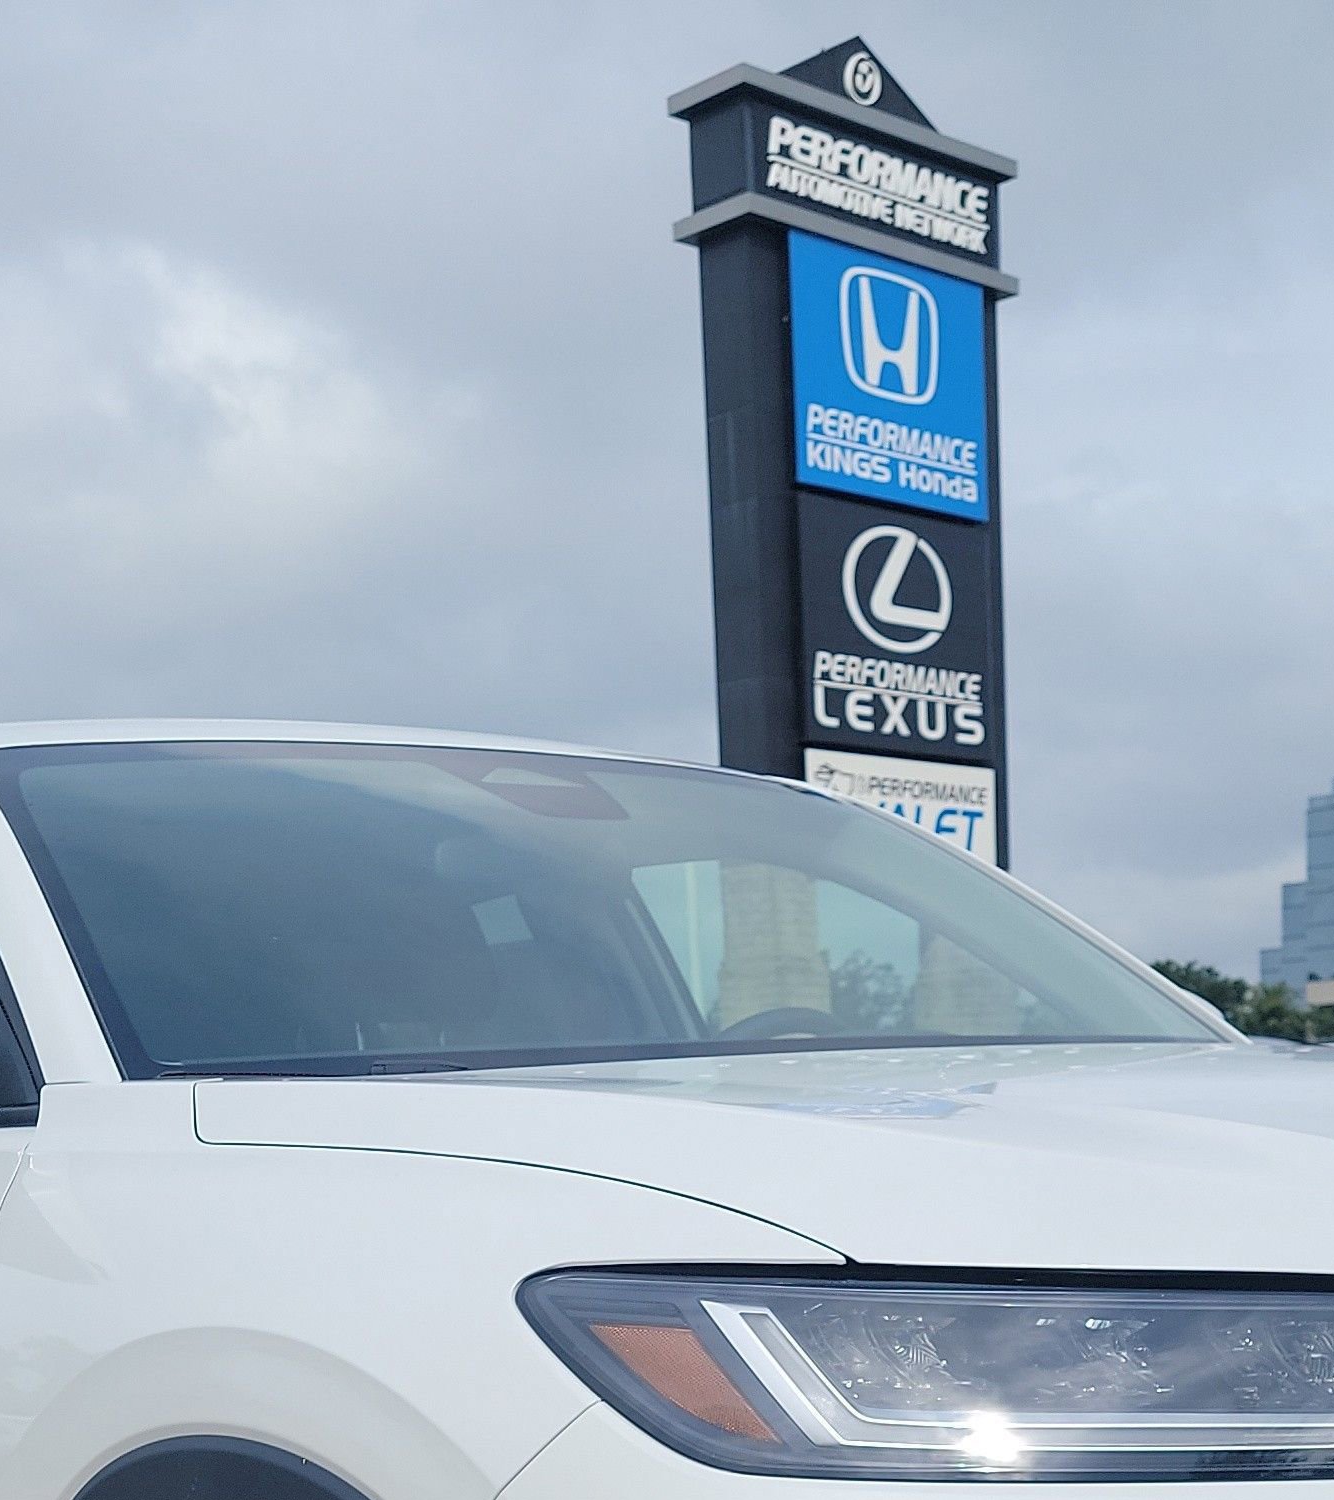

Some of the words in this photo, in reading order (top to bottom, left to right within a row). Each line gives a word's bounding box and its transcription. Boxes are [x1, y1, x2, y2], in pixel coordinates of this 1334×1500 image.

[768, 115, 990, 223] PERFORMANCE
[766, 163, 895, 226] AUTOMOTIVE
[894, 203, 989, 255] NETWORK
[806, 403, 979, 471] PERFORMANCE
[806, 440, 893, 484] KINGS
[814, 650, 984, 701] PERFORMANCE
[814, 683, 986, 746] LEXUS
[868, 775, 989, 806] PERFORMANCE
